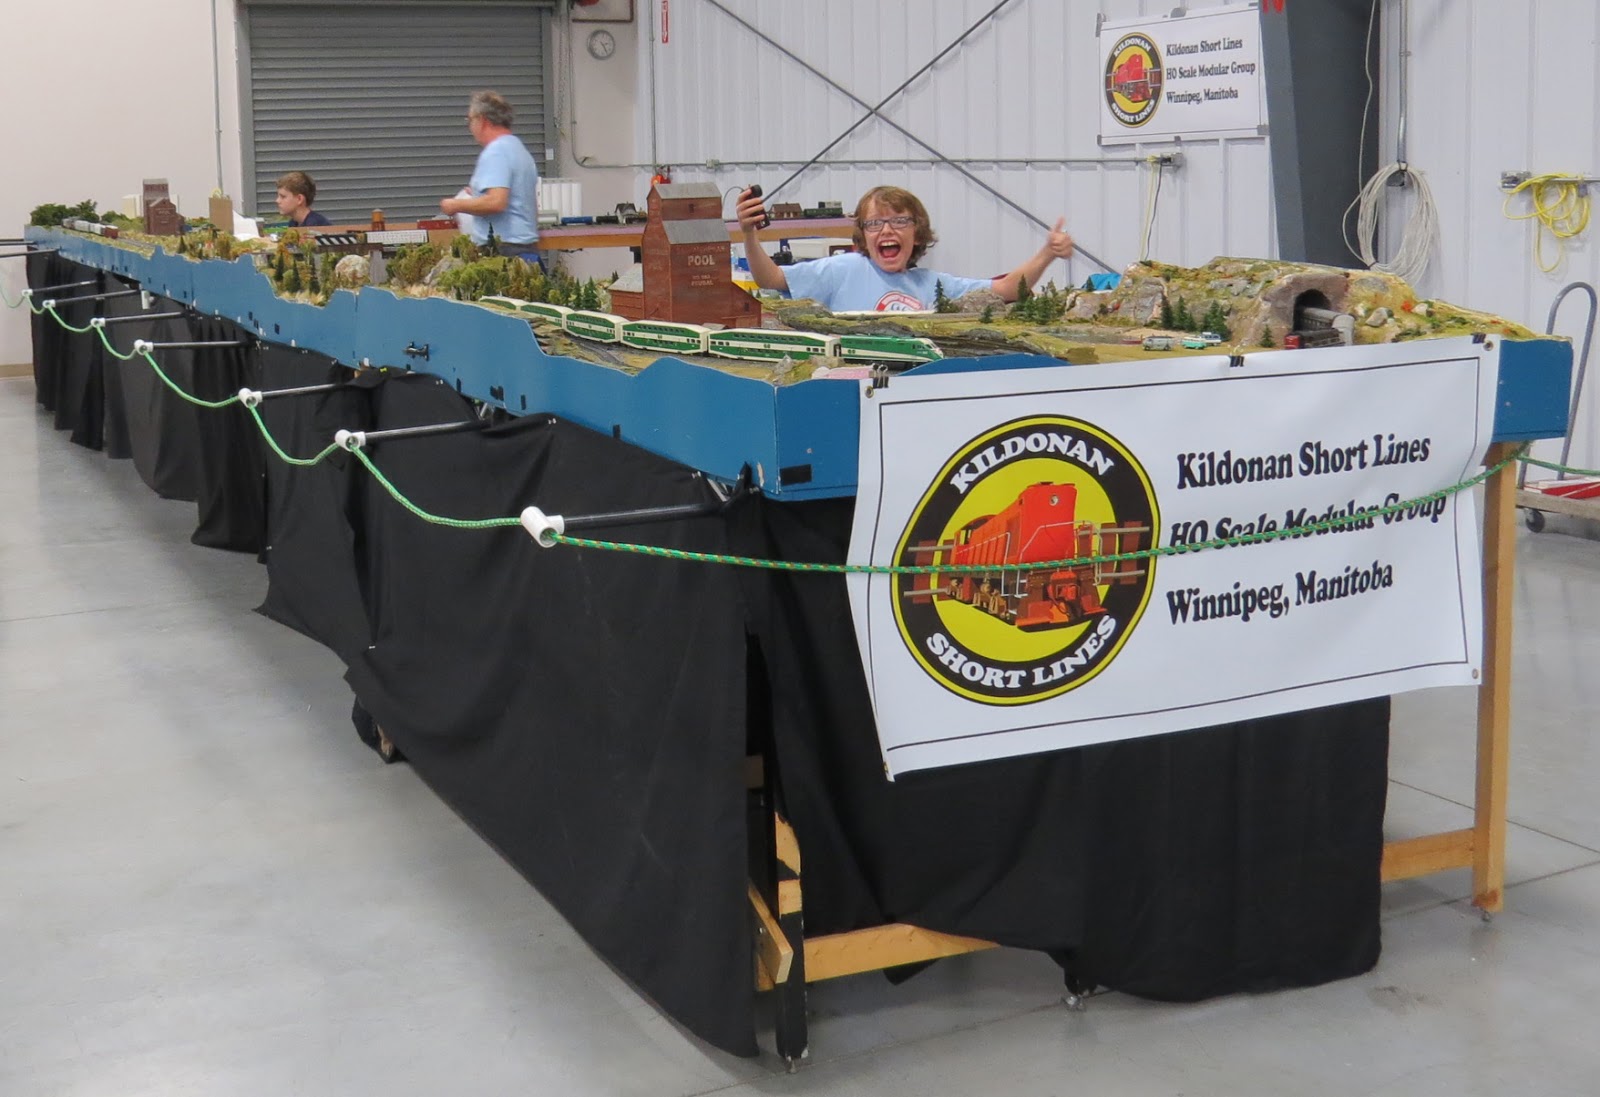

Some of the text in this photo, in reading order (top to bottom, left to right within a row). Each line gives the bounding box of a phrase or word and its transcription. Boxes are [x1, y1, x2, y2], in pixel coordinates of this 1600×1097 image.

[1113, 38, 1151, 57] KILDONAN
[1166, 37, 1243, 56] Kildonan Short Lines
[1166, 61, 1256, 80] HO Scale Modular Group
[1166, 87, 1239, 105] Winnipeg, Manitoba
[1111, 99, 1155, 122] SHORT LINES
[687, 254, 715, 266] POOL
[950, 432, 1115, 495] KILDONAN
[1177, 433, 1431, 489] Kildonan Short Lines
[1167, 492, 1447, 556] HO Scale Modular Group
[1166, 560, 1393, 626] Winnipeg, Manitoba
[926, 614, 1117, 690] SHORT LINES
